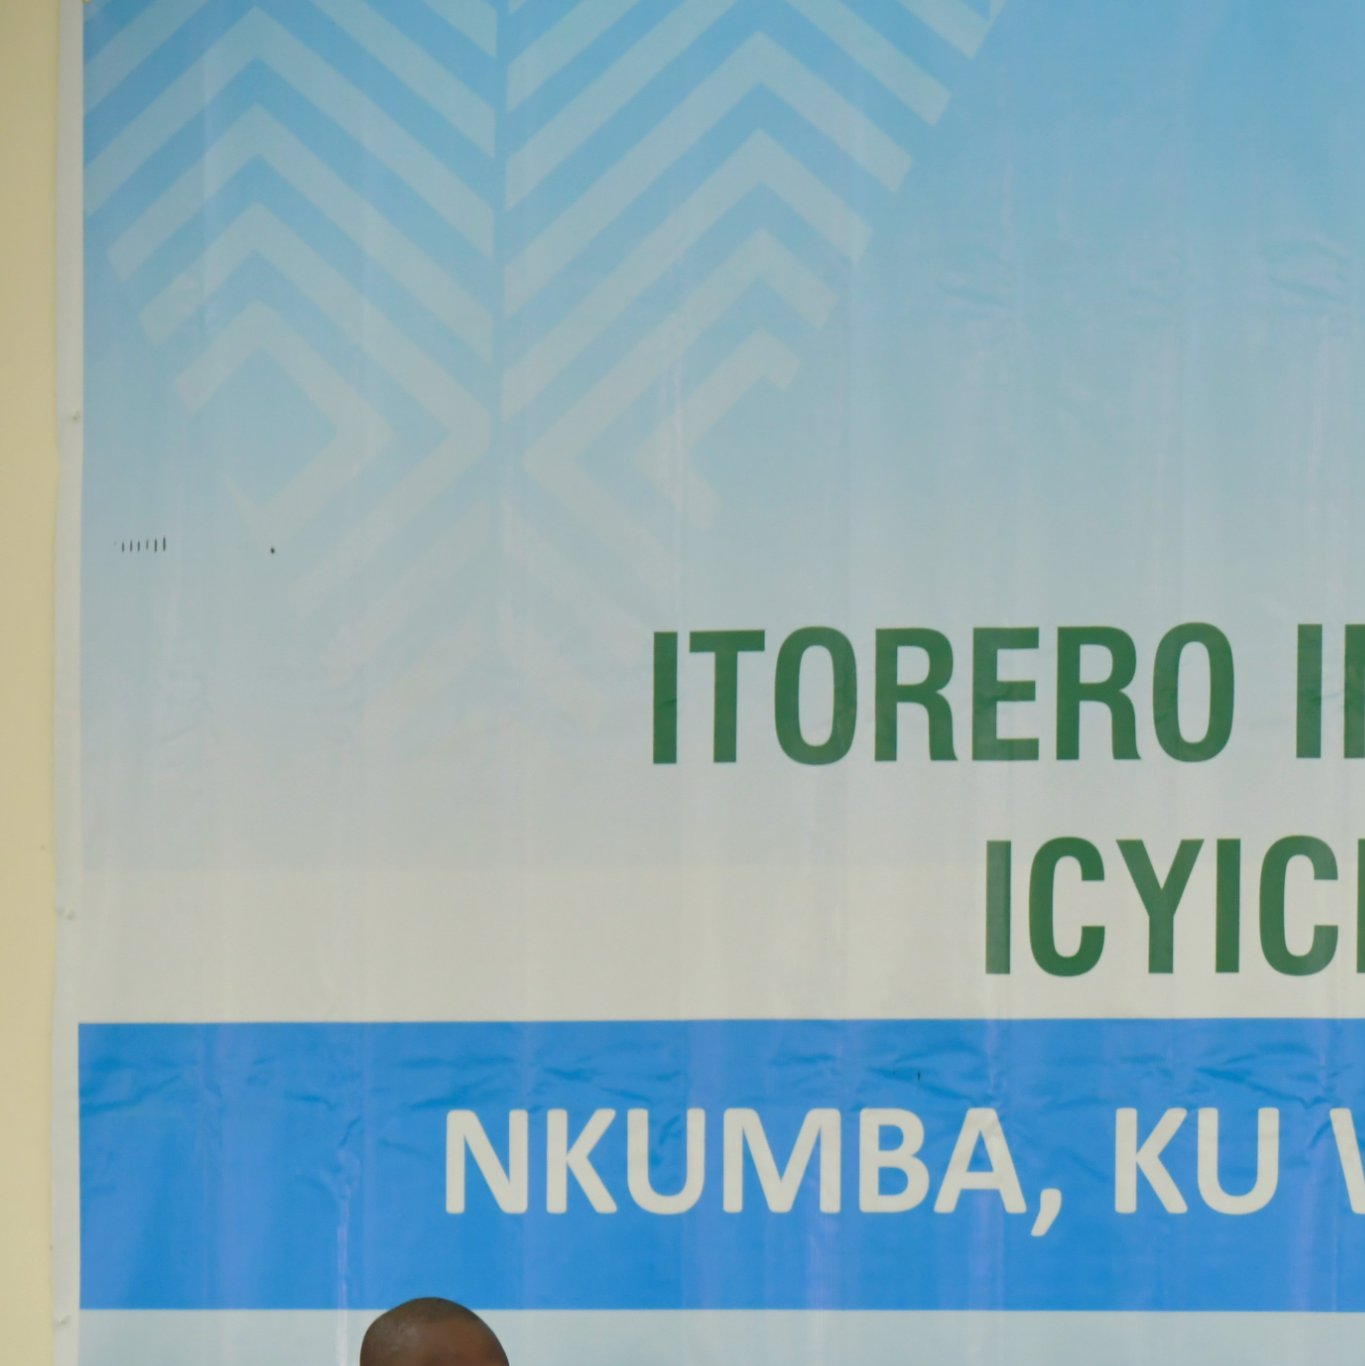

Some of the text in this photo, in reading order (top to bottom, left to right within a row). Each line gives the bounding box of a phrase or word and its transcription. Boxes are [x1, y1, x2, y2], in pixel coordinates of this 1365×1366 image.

[652, 622, 1235, 766] ITORERO
[445, 1107, 1062, 1237] NKUMBA,
[1114, 1107, 1280, 1215] KU
